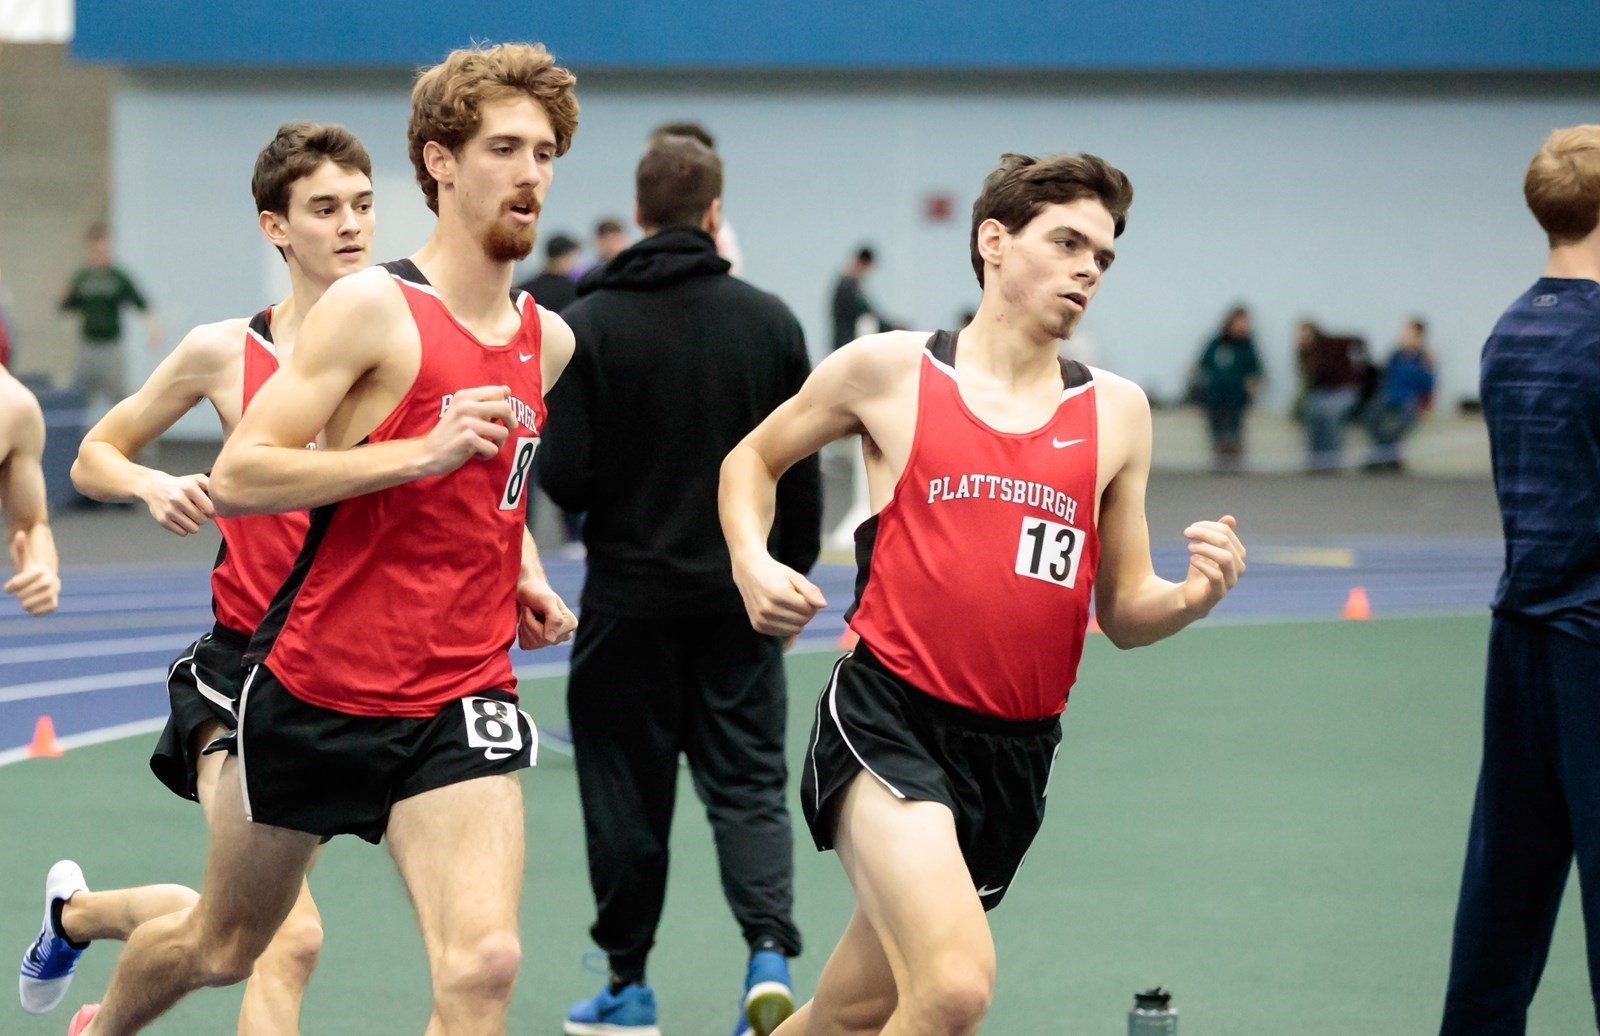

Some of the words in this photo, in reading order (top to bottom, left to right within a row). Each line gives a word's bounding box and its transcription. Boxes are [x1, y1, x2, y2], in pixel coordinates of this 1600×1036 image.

[507, 442, 533, 505] 8
[927, 474, 1077, 525] PLATTSBURGH
[1027, 522, 1076, 582] 13
[472, 698, 513, 742] 8
